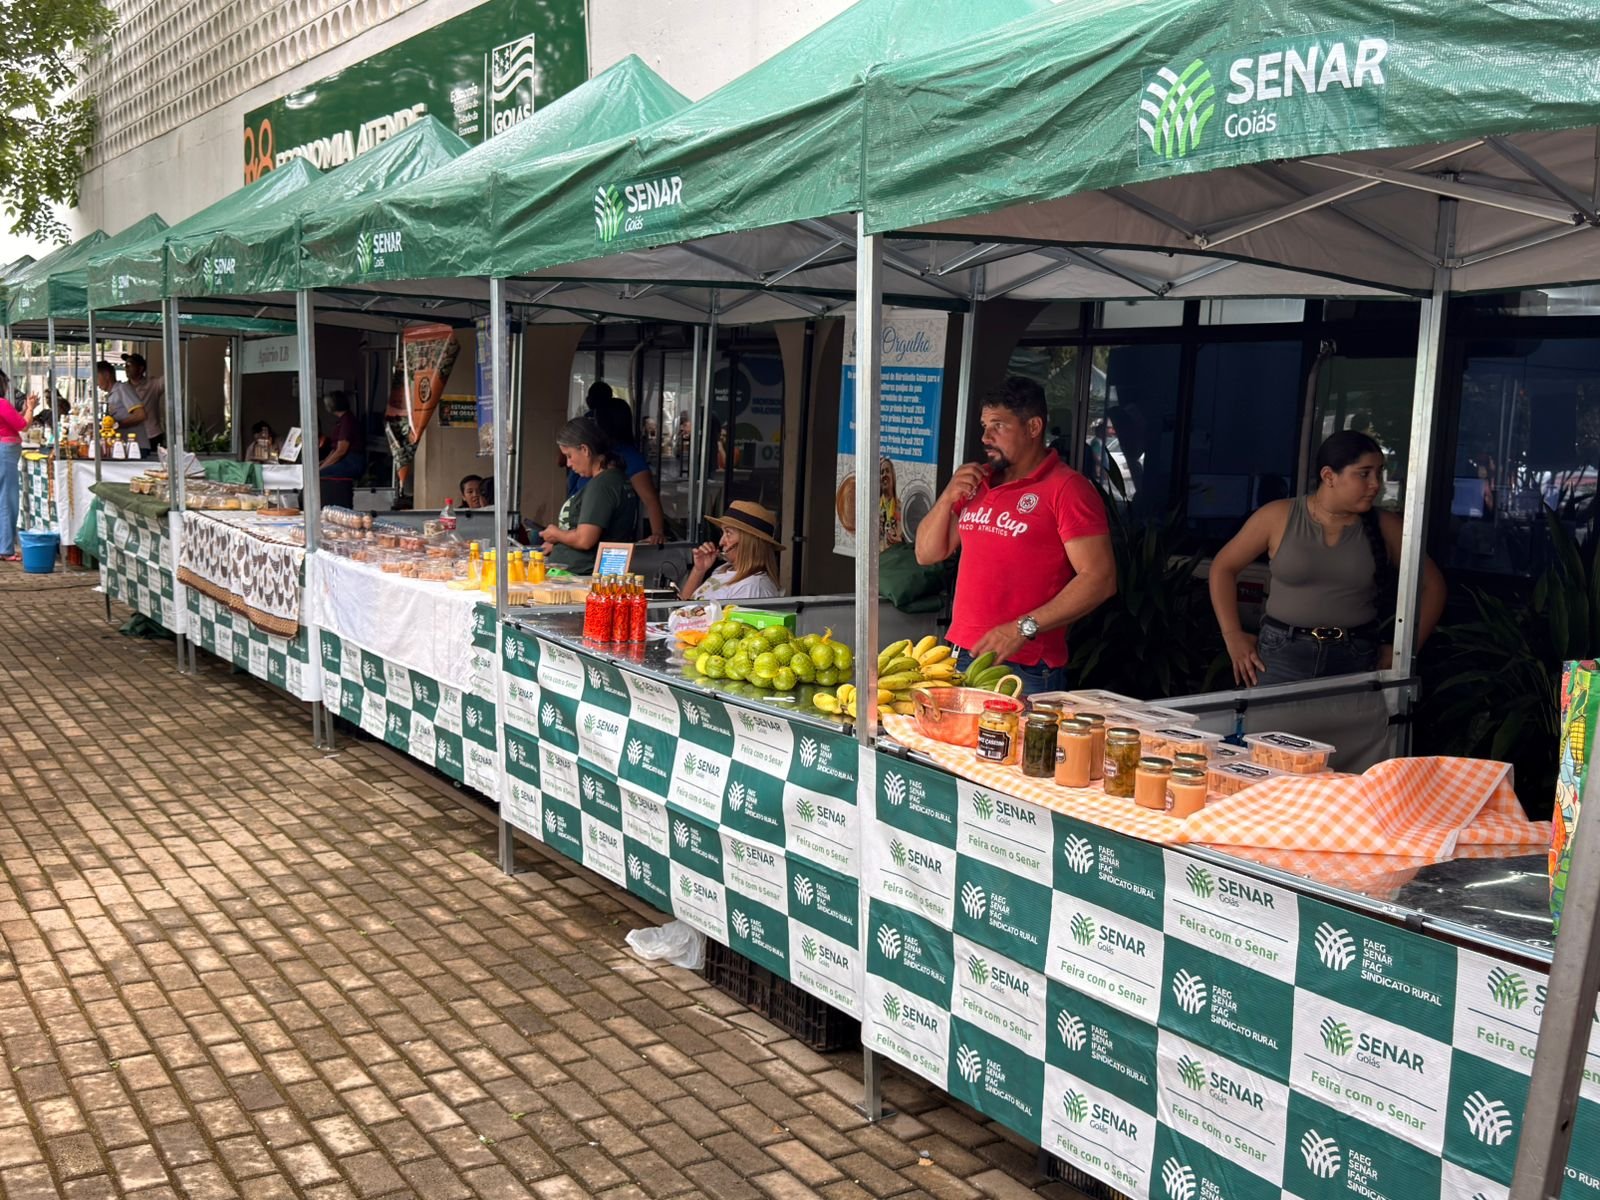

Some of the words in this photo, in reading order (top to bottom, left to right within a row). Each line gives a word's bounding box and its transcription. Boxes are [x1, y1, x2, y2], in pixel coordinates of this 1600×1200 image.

[1226, 38, 1388, 105] SENAR
[1224, 107, 1276, 138] Goiás
[625, 176, 682, 213] SENAR
[373, 231, 403, 253] SENAR
[214, 258, 236, 274] SENAR
[882, 326, 931, 362] Orgulho
[996, 511, 1028, 537] Cup
[596, 719, 619, 735] SENAR
[698, 759, 720, 777] SENAR
[909, 779, 922, 788] FAEG
[909, 786, 926, 798] SENAR
[909, 794, 921, 805] IFAG
[817, 805, 846, 827] SENAR
[909, 802, 935, 817] SINDICATO
[934, 811, 952, 823] RURAL
[996, 800, 1037, 825] SENAR
[746, 846, 775, 867] SENAR
[908, 849, 942, 874] SENAR
[968, 834, 990, 852] Feira
[991, 842, 1007, 858] com
[1008, 850, 1015, 859] o
[1016, 851, 1040, 870] Senar
[1099, 845, 1115, 858] FAEG
[1099, 854, 1120, 867] SENAR
[1098, 863, 1113, 875] IFAG
[693, 882, 718, 903] SENAR
[1098, 871, 1132, 892] SINDICATO
[1132, 885, 1156, 900] RURAL
[1218, 877, 1275, 909] SENAR
[883, 880, 903, 898] Feira
[904, 889, 919, 901] com
[919, 896, 924, 905] o
[925, 897, 944, 916] Senar
[991, 893, 1006, 905] FAEG
[991, 901, 1010, 914] SENAR
[1218, 893, 1239, 908] Goiás
[989, 910, 1002, 921] IFAG
[904, 935, 918, 945] FAEG
[989, 917, 1019, 936] SINDICATO
[1018, 929, 1038, 945] RURAL
[1180, 914, 1206, 935] Feira
[1209, 927, 1231, 945] com
[1235, 937, 1242, 947] o
[1244, 940, 1279, 962] Senar
[904, 942, 921, 956] SENAR
[1098, 941, 1114, 955] Goiás
[1099, 925, 1145, 958] SENAR
[1363, 938, 1386, 954] FAEG
[819, 945, 849, 970] SENAR
[904, 951, 916, 962] IFAG
[1362, 959, 1383, 973] IFAG
[1363, 948, 1393, 966] SENAR
[904, 958, 931, 976] SINDICATO
[930, 969, 946, 984] RURAL
[992, 966, 1029, 997] SENAR
[1061, 960, 1085, 981] Feira
[1087, 971, 1107, 989] com
[1108, 982, 1115, 992] o
[1117, 983, 1147, 1006] Senar
[1361, 970, 1410, 994] SINDICATO
[1411, 987, 1442, 1007] RURAL
[1212, 985, 1232, 1000] FAEG
[1211, 1005, 1228, 1018] IFAG
[1212, 994, 1237, 1012] SENAR
[901, 1005, 938, 1034] SENAR
[963, 997, 983, 1017] Feira
[984, 1007, 1000, 1024] com
[1002, 1019, 1008, 1028] o
[1009, 1020, 1032, 1041] Senar
[1091, 1025, 1108, 1040] FAEG
[1091, 1034, 1113, 1049] SENAR
[1211, 1014, 1251, 1038] SINDICATO
[1252, 1031, 1278, 1050] RURAL
[1091, 1045, 1106, 1056] IFAG
[1358, 1033, 1424, 1073] SENAR
[1477, 1026, 1515, 1050] Feira
[1519, 1045, 1536, 1060] co
[876, 1033, 896, 1051] Feira
[897, 1044, 911, 1060] com
[913, 1053, 918, 1062] o
[919, 1055, 940, 1075] Senar
[987, 1058, 1001, 1070] FAEG
[1356, 1052, 1381, 1069] Goiás
[986, 1066, 1006, 1082] SENAR
[1091, 1052, 1127, 1075] SINDICATO
[1126, 1067, 1149, 1086] RURAL
[985, 1075, 998, 1086] IFAG
[985, 1083, 1015, 1105] SINDICATO
[1014, 1099, 1032, 1117] RURAL
[1209, 1088, 1228, 1105] Goiás
[1210, 1072, 1264, 1111] SENAR
[1312, 1071, 1341, 1095] Feira
[1345, 1086, 1372, 1106] com
[1376, 1100, 1385, 1112] o
[1388, 1104, 1426, 1131] Senar
[1089, 1120, 1108, 1134] Goiás
[1091, 1103, 1137, 1141] SENAR
[1172, 1104, 1199, 1126] Feira
[1201, 1118, 1222, 1138] com
[1225, 1133, 1231, 1144] o
[1234, 1137, 1267, 1162] Senar
[1056, 1133, 1078, 1155] Feira
[1080, 1148, 1101, 1167] com
[1104, 1161, 1110, 1171] o
[1111, 1165, 1138, 1189] Senar
[1349, 1150, 1371, 1166] FAEG
[1347, 1170, 1367, 1186] IFAG
[1348, 1160, 1378, 1180] SENAR
[1201, 1177, 1219, 1194] FAEG
[1347, 1180, 1393, 1200] SINDICA
[1579, 1173, 1600, 1190] RUR
